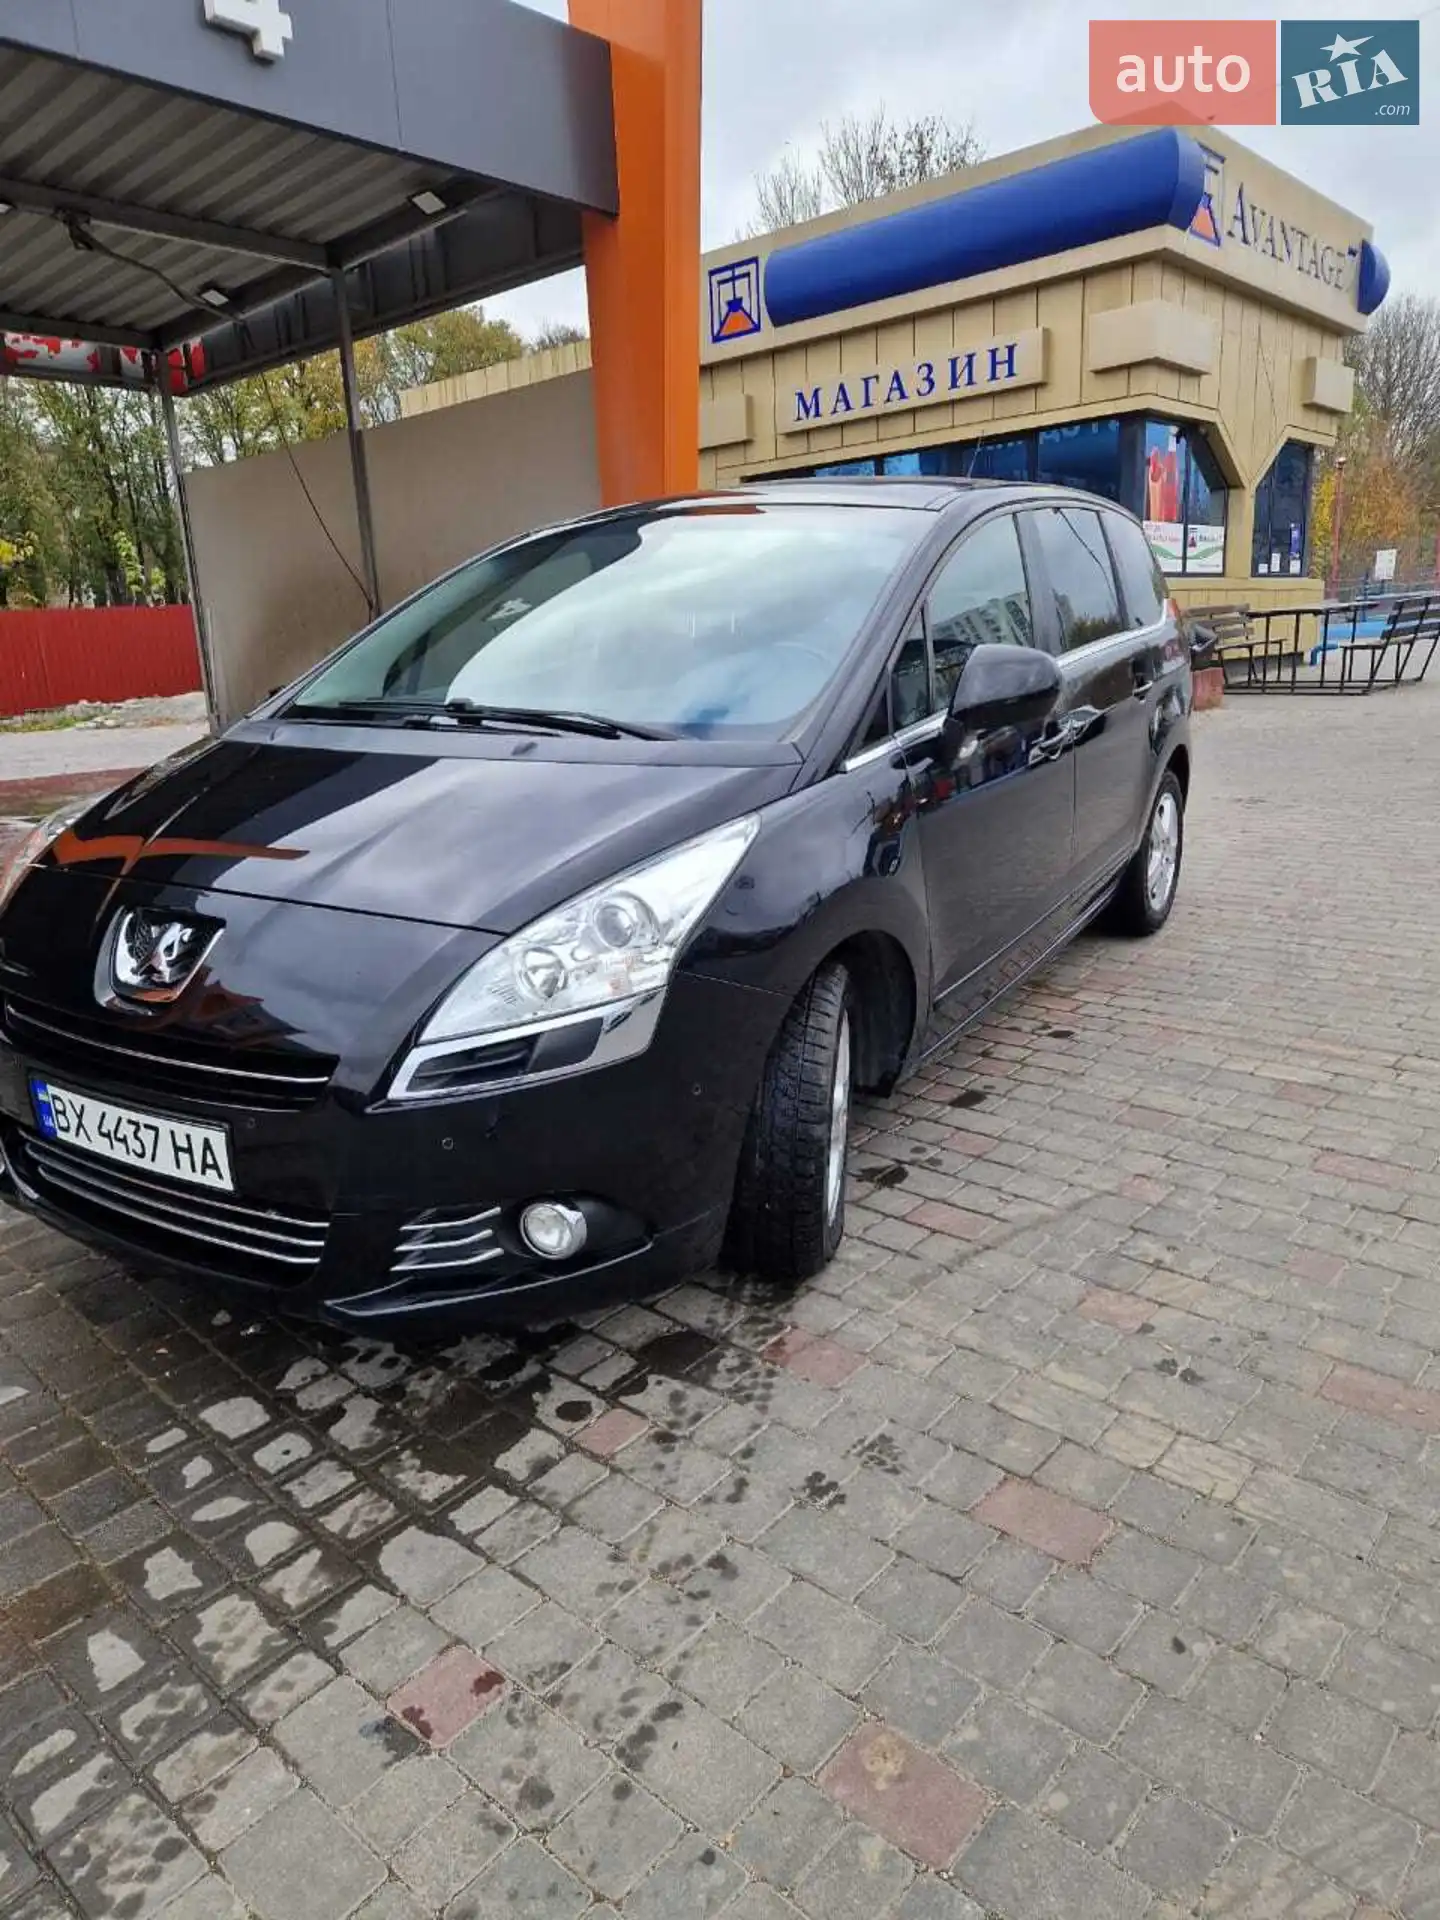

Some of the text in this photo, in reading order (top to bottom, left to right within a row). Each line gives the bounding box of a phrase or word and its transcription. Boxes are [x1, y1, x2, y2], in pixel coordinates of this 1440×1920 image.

[793, 343, 1018, 422] МАГАЗИН
[50, 1093, 224, 1180] BX 4437 HA
